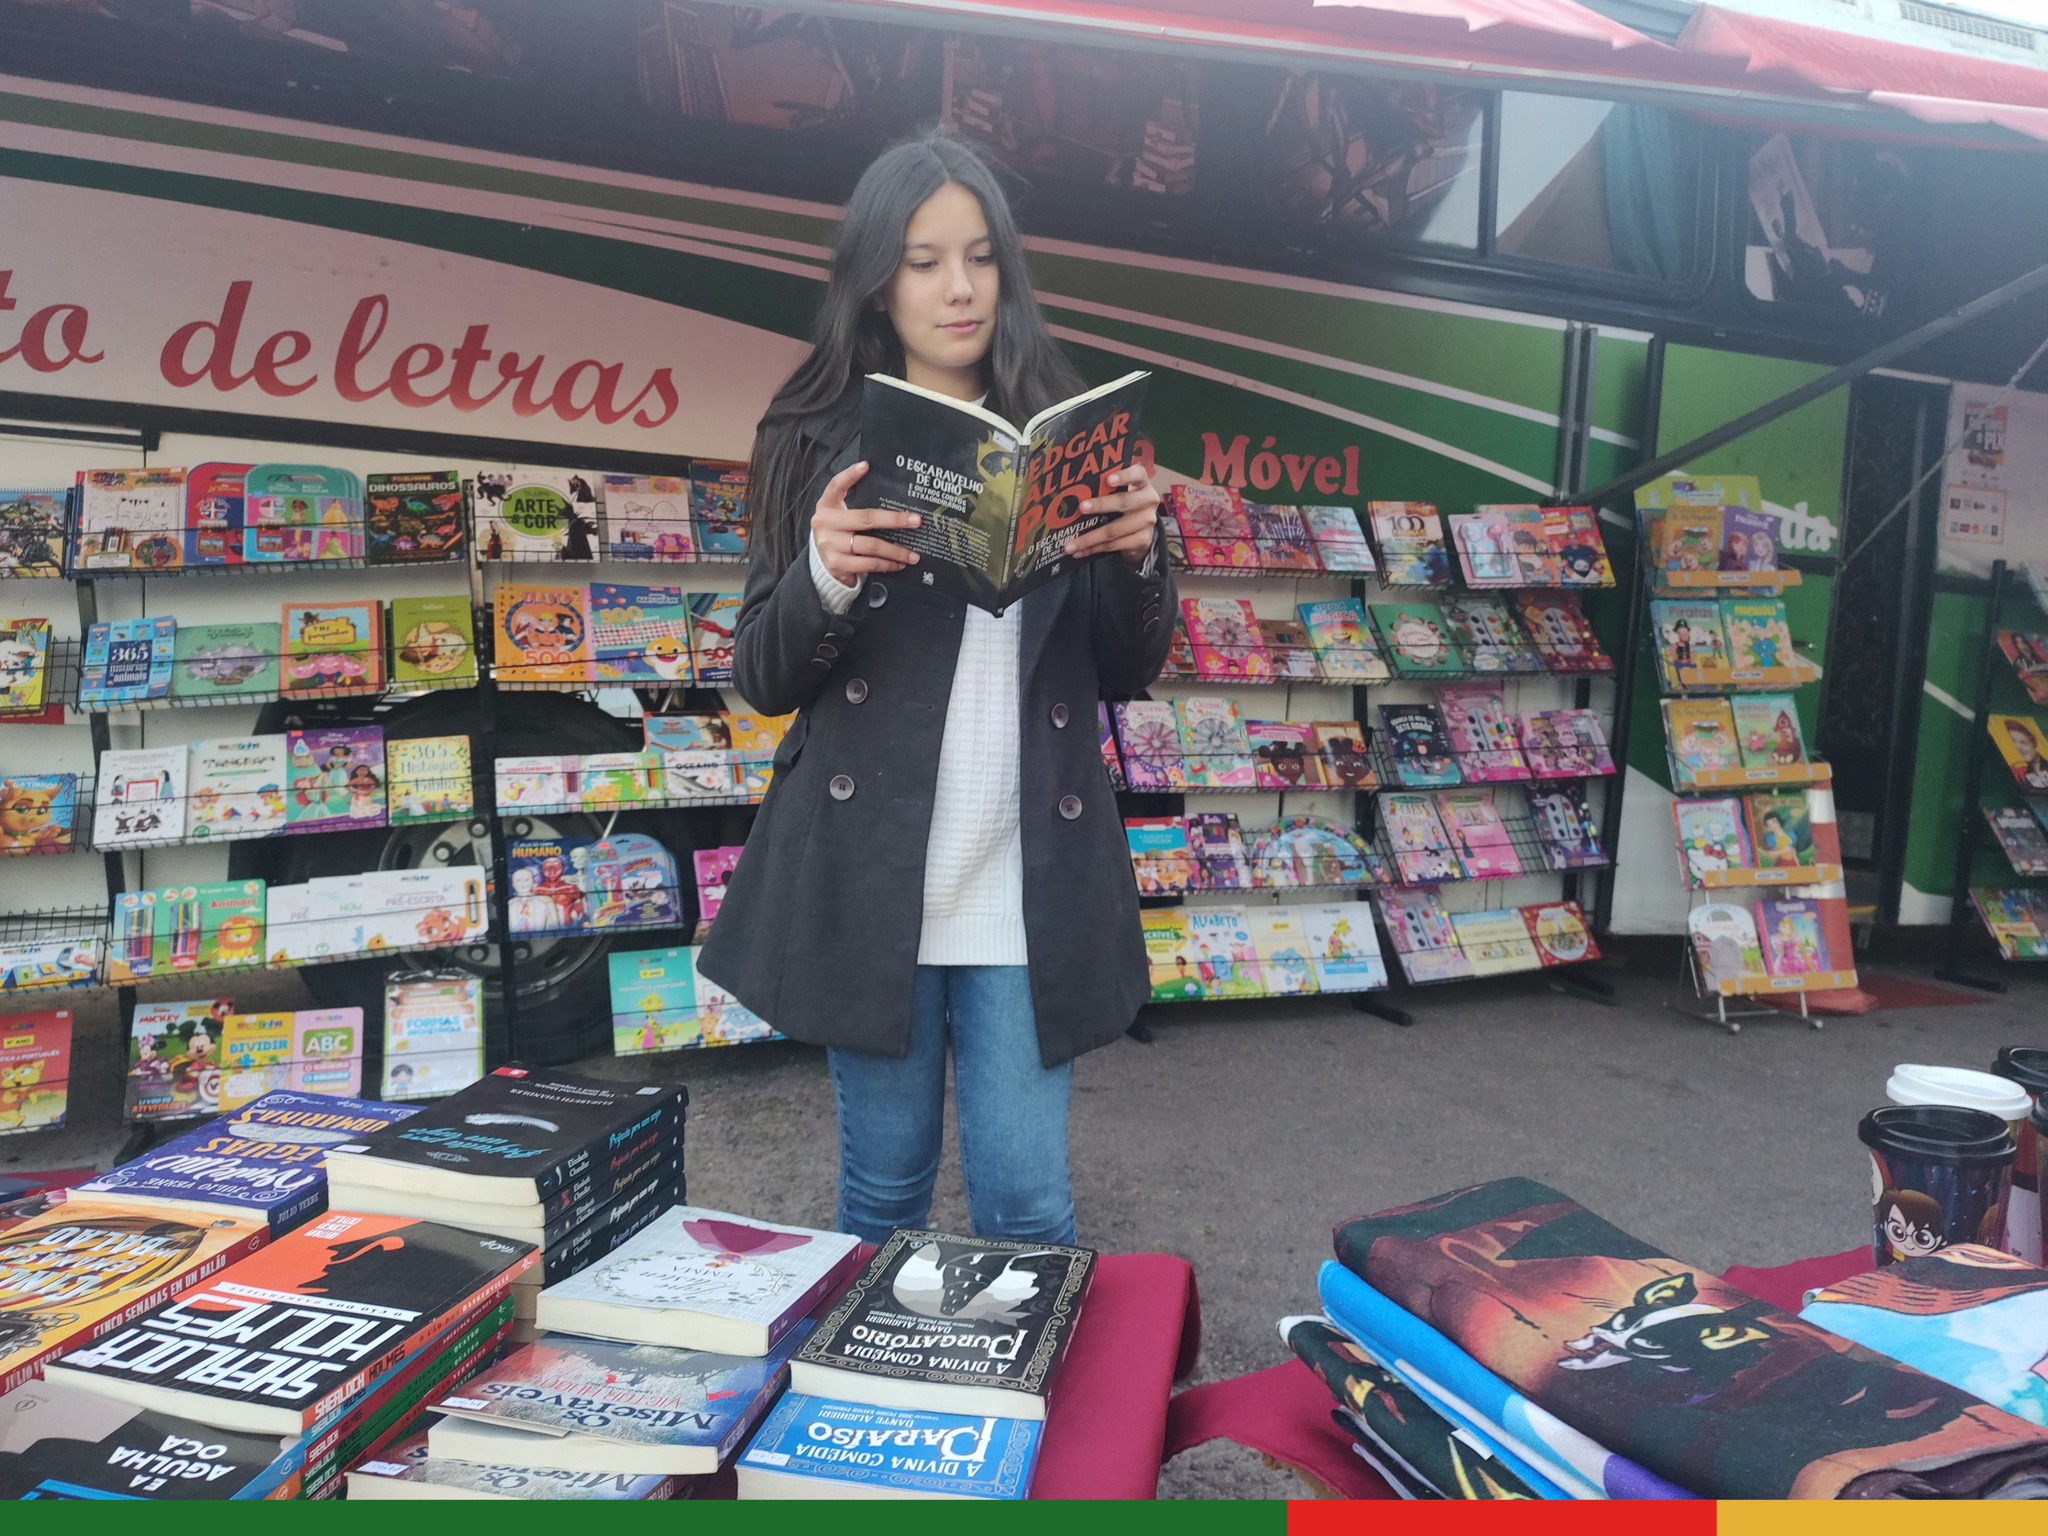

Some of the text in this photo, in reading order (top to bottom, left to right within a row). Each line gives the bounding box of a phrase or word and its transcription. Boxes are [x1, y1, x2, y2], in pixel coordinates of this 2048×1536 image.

[160, 281, 680, 428] de letras
[1028, 412, 1130, 485] EDGAR
[896, 454, 984, 495] O ESCARAVELHO
[1022, 437, 1125, 513] ALLAN
[1199, 432, 1360, 496] Móvel
[369, 481, 456, 495] DINOSSAUROS
[914, 484, 941, 498] OUTROS
[942, 491, 967, 507] CONTOS
[916, 473, 962, 496] DE OURO
[514, 499, 556, 514] ARTE
[1014, 463, 1124, 554] POE
[511, 513, 557, 529] & COR
[1035, 516, 1099, 551] ESCARAVELHO
[1386, 515, 1425, 530] 100
[600, 606, 643, 625] 500
[111, 647, 150, 662] 365
[523, 650, 574, 668] 500
[411, 743, 448, 760] 365
[511, 846, 563, 858] HUMANO
[1192, 914, 1238, 930] ALFABETO
[229, 1039, 289, 1054] DIVIDIR
[305, 1033, 350, 1054] ABC
[228, 1108, 390, 1134] UBMARINAS
[195, 1138, 326, 1169] ÉGUAS
[28, 1250, 145, 1274] SEMANAS
[0, 1266, 103, 1303] CINC
[93, 1254, 228, 1340] CINCO SEMANAS EM UM BALÃO
[462, 1274, 511, 1312] BASKERVILLE
[142, 1293, 405, 1362] HOLMES
[864, 1314, 953, 1335] DANTE ALIGHIERI
[453, 1326, 481, 1354] QUATRO
[453, 1340, 481, 1367] QUATRO
[843, 1343, 1012, 1375] A DIVINA COMÉDIA
[314, 1344, 407, 1422] SHERLOCK HOLMES
[562, 1410, 611, 1429] Os
[817, 1409, 915, 1428] DANTE ALIGHIERI
[158, 1434, 228, 1460] OCA
[807, 1417, 998, 1463] PARAÍSO
[107, 1446, 237, 1482] AGULHA
[795, 1442, 982, 1478] A DIVINA COMÉDIA
[478, 1471, 528, 1490] Os
